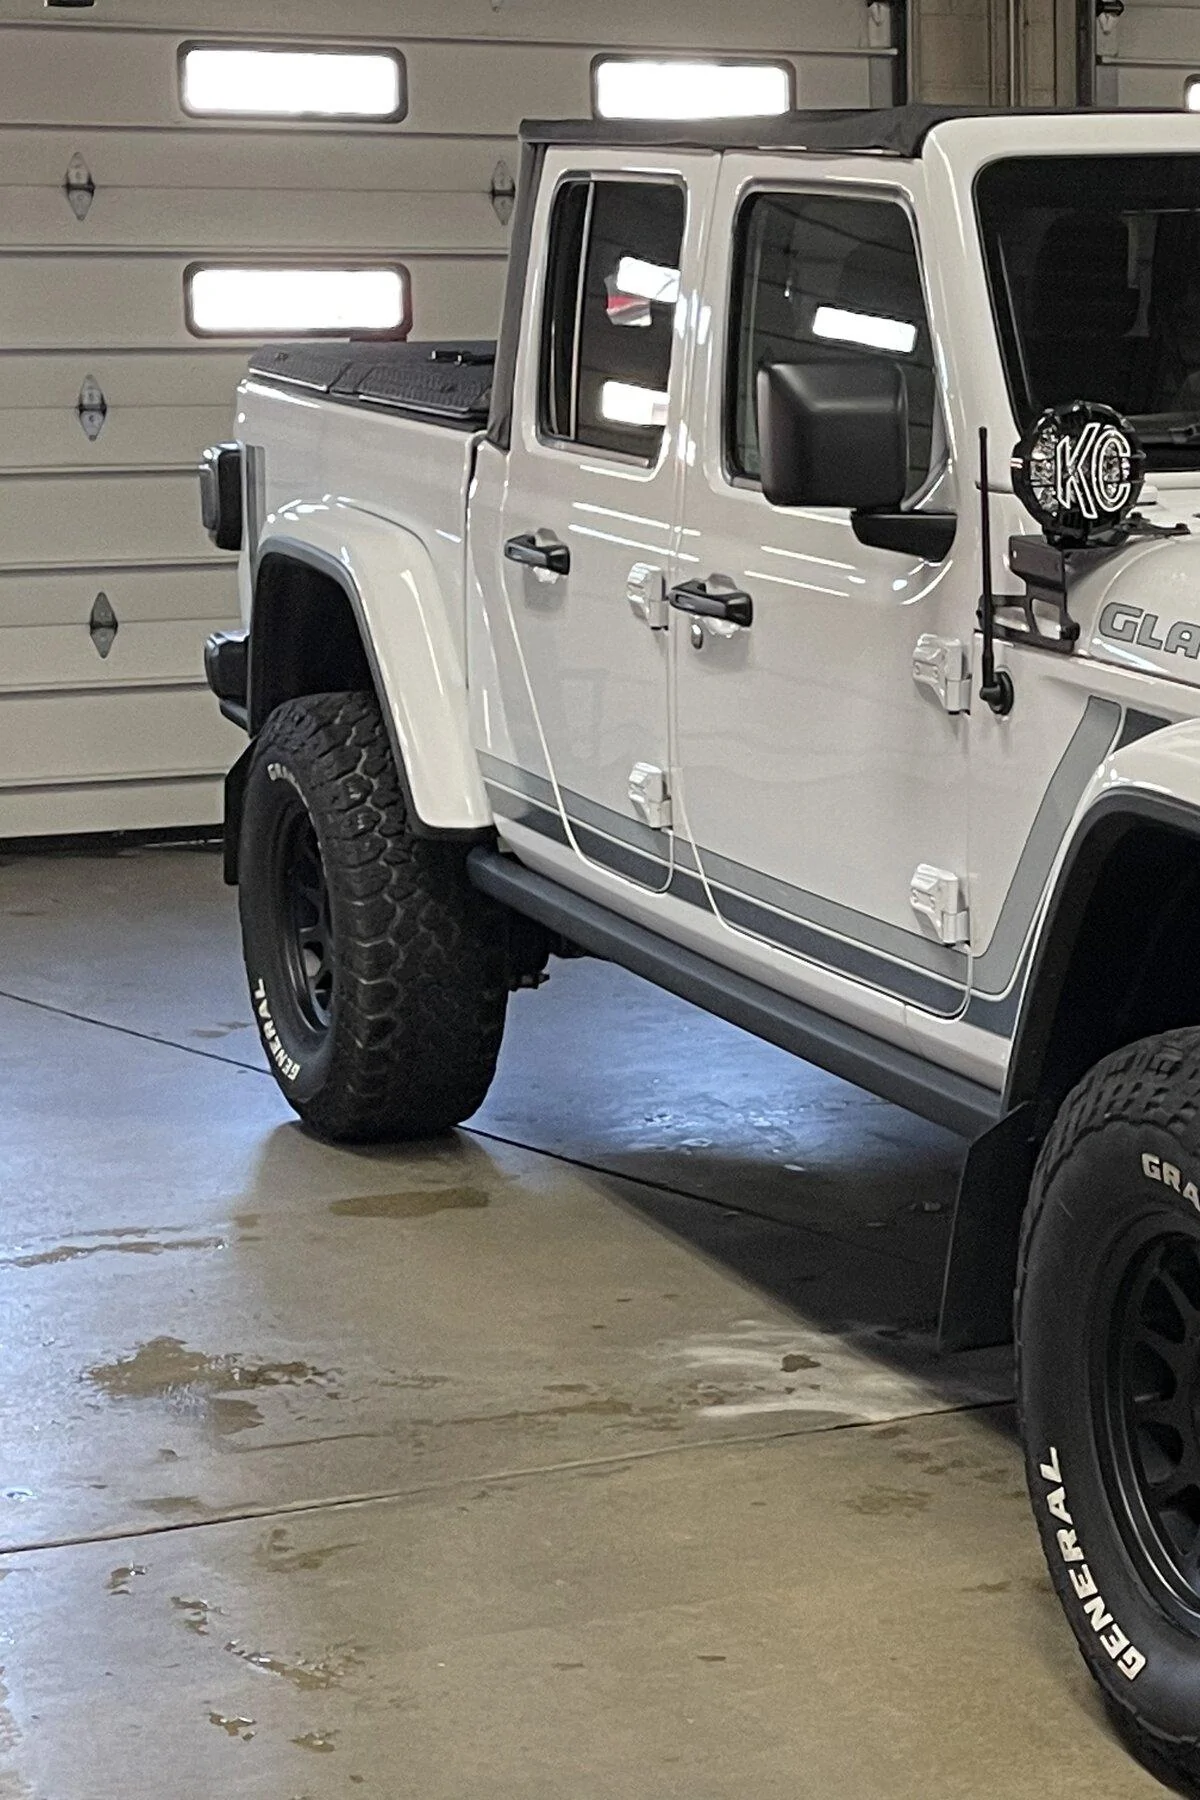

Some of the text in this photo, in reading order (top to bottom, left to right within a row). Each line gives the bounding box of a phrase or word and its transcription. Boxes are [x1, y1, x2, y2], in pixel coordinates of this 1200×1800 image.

[1057, 422, 1131, 519] KC
[254, 978, 301, 1081] GENERAL
[1040, 1446, 1147, 1681] GENERAL
